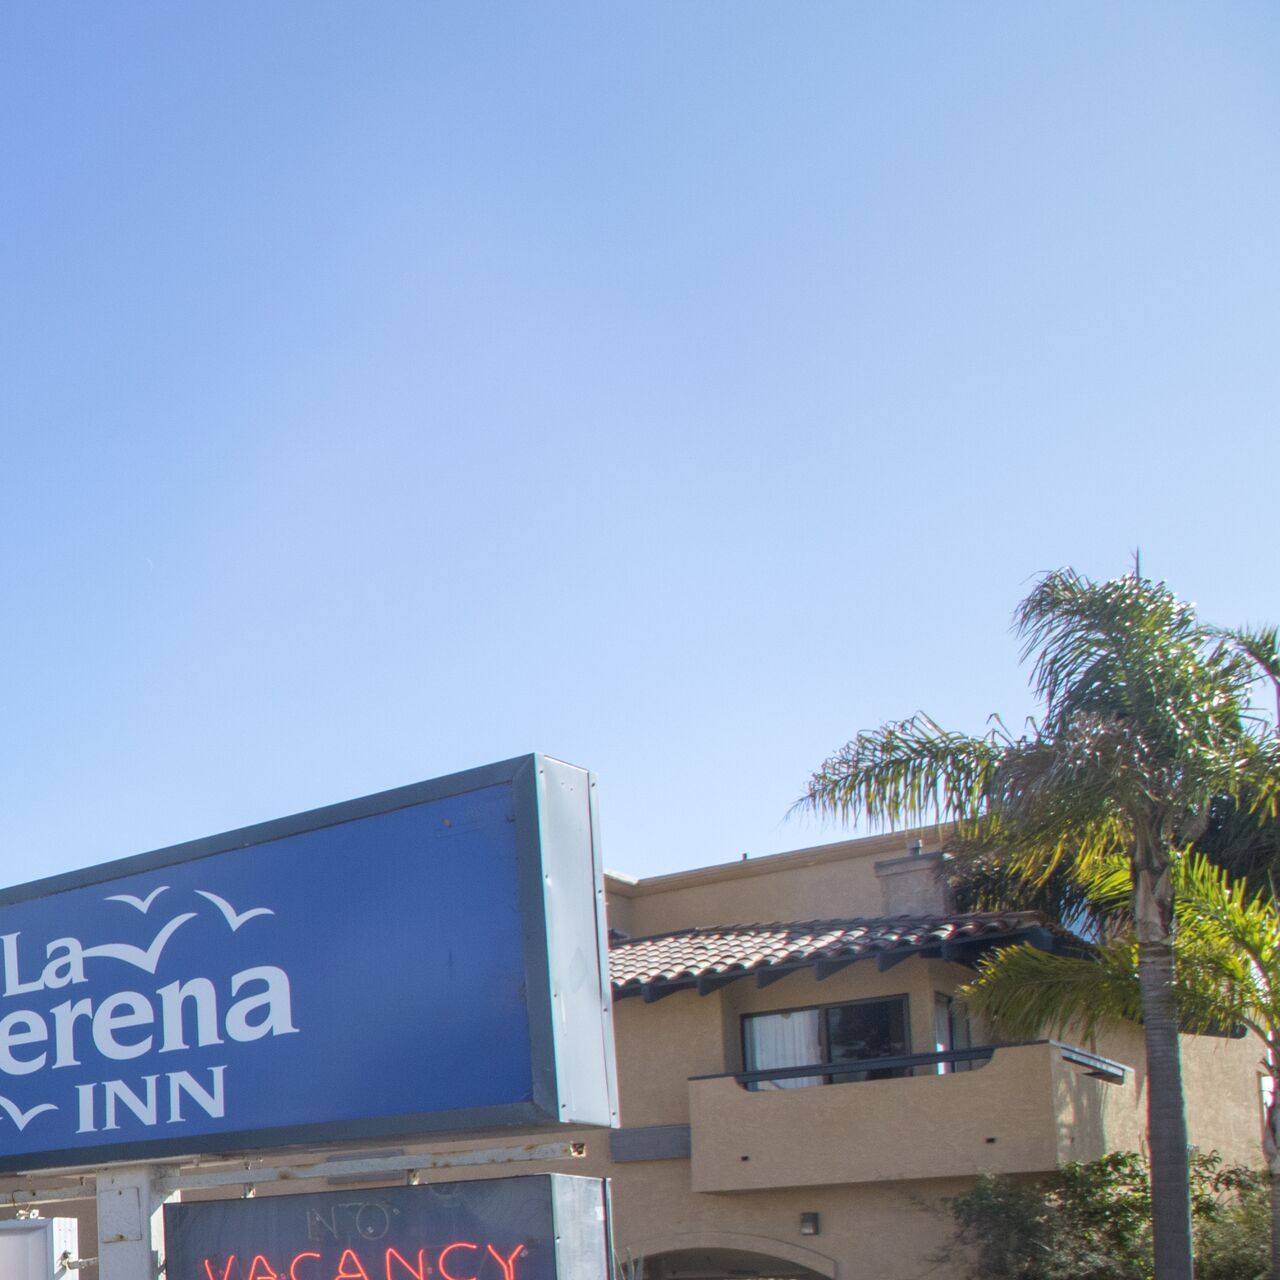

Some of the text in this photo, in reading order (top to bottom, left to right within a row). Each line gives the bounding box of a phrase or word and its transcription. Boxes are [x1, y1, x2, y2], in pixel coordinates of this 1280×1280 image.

[0, 931, 88, 997] La
[74, 1065, 228, 1134] INN
[306, 1202, 390, 1240] NO
